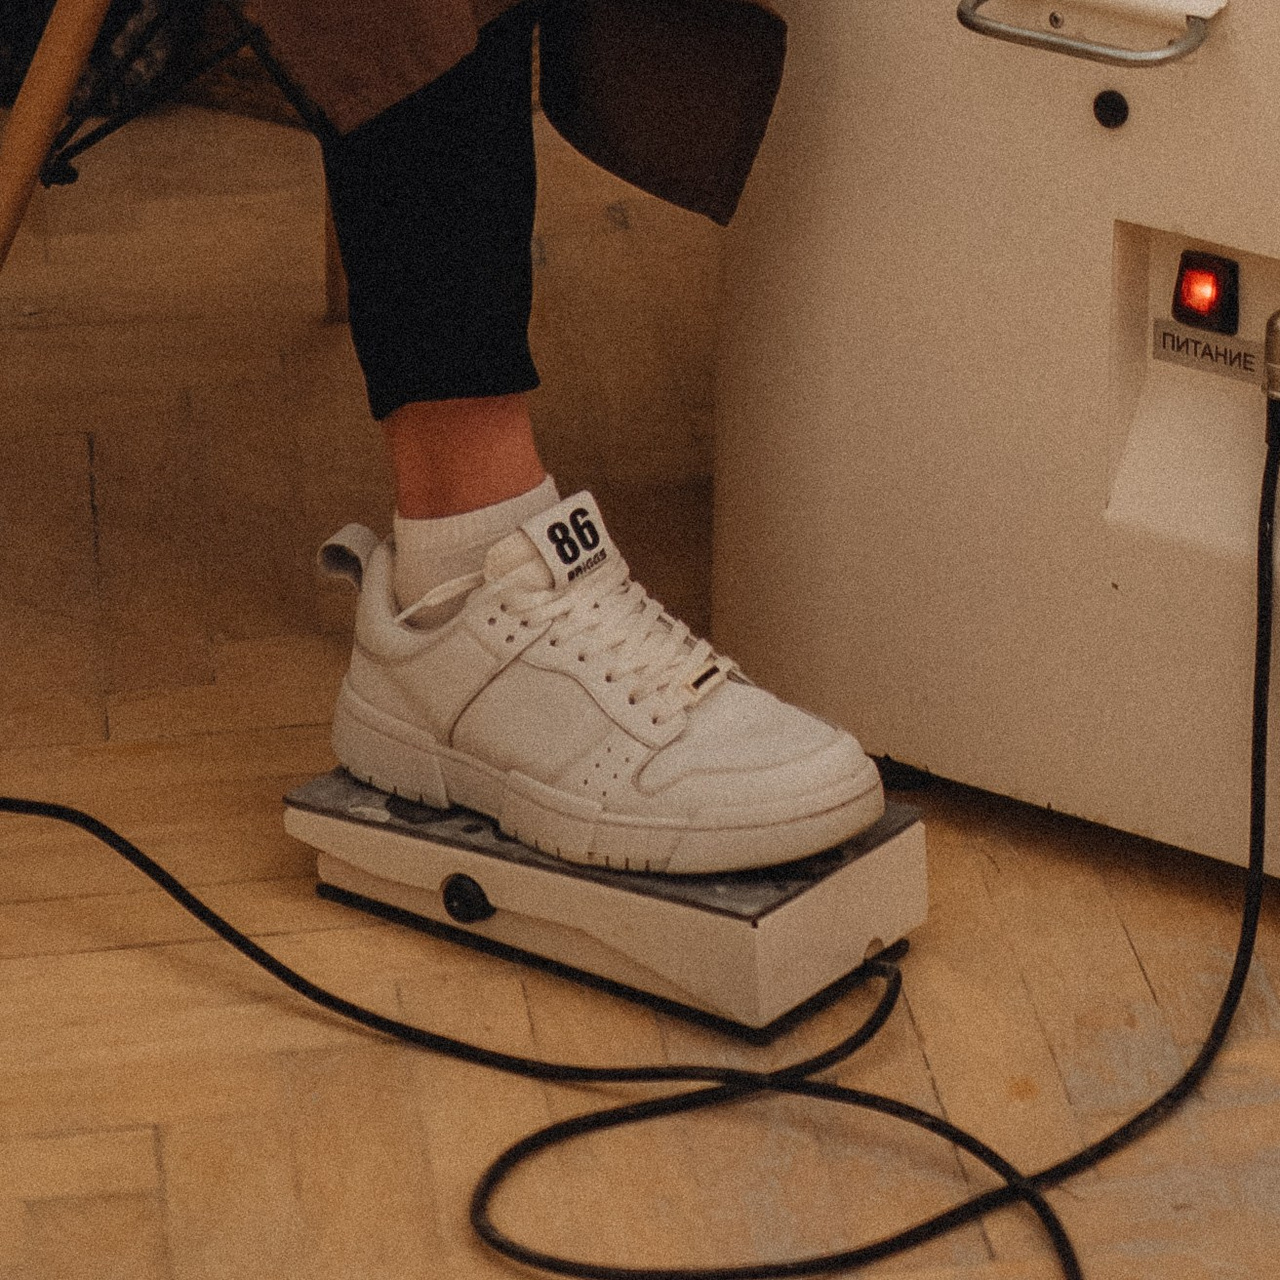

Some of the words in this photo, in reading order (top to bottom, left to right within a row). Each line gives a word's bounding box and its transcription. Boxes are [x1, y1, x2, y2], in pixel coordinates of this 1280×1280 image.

[1162, 332, 1257, 372] ПИТАНИЕ
[547, 507, 600, 565] 86
[567, 548, 607, 582] BRIGGS
